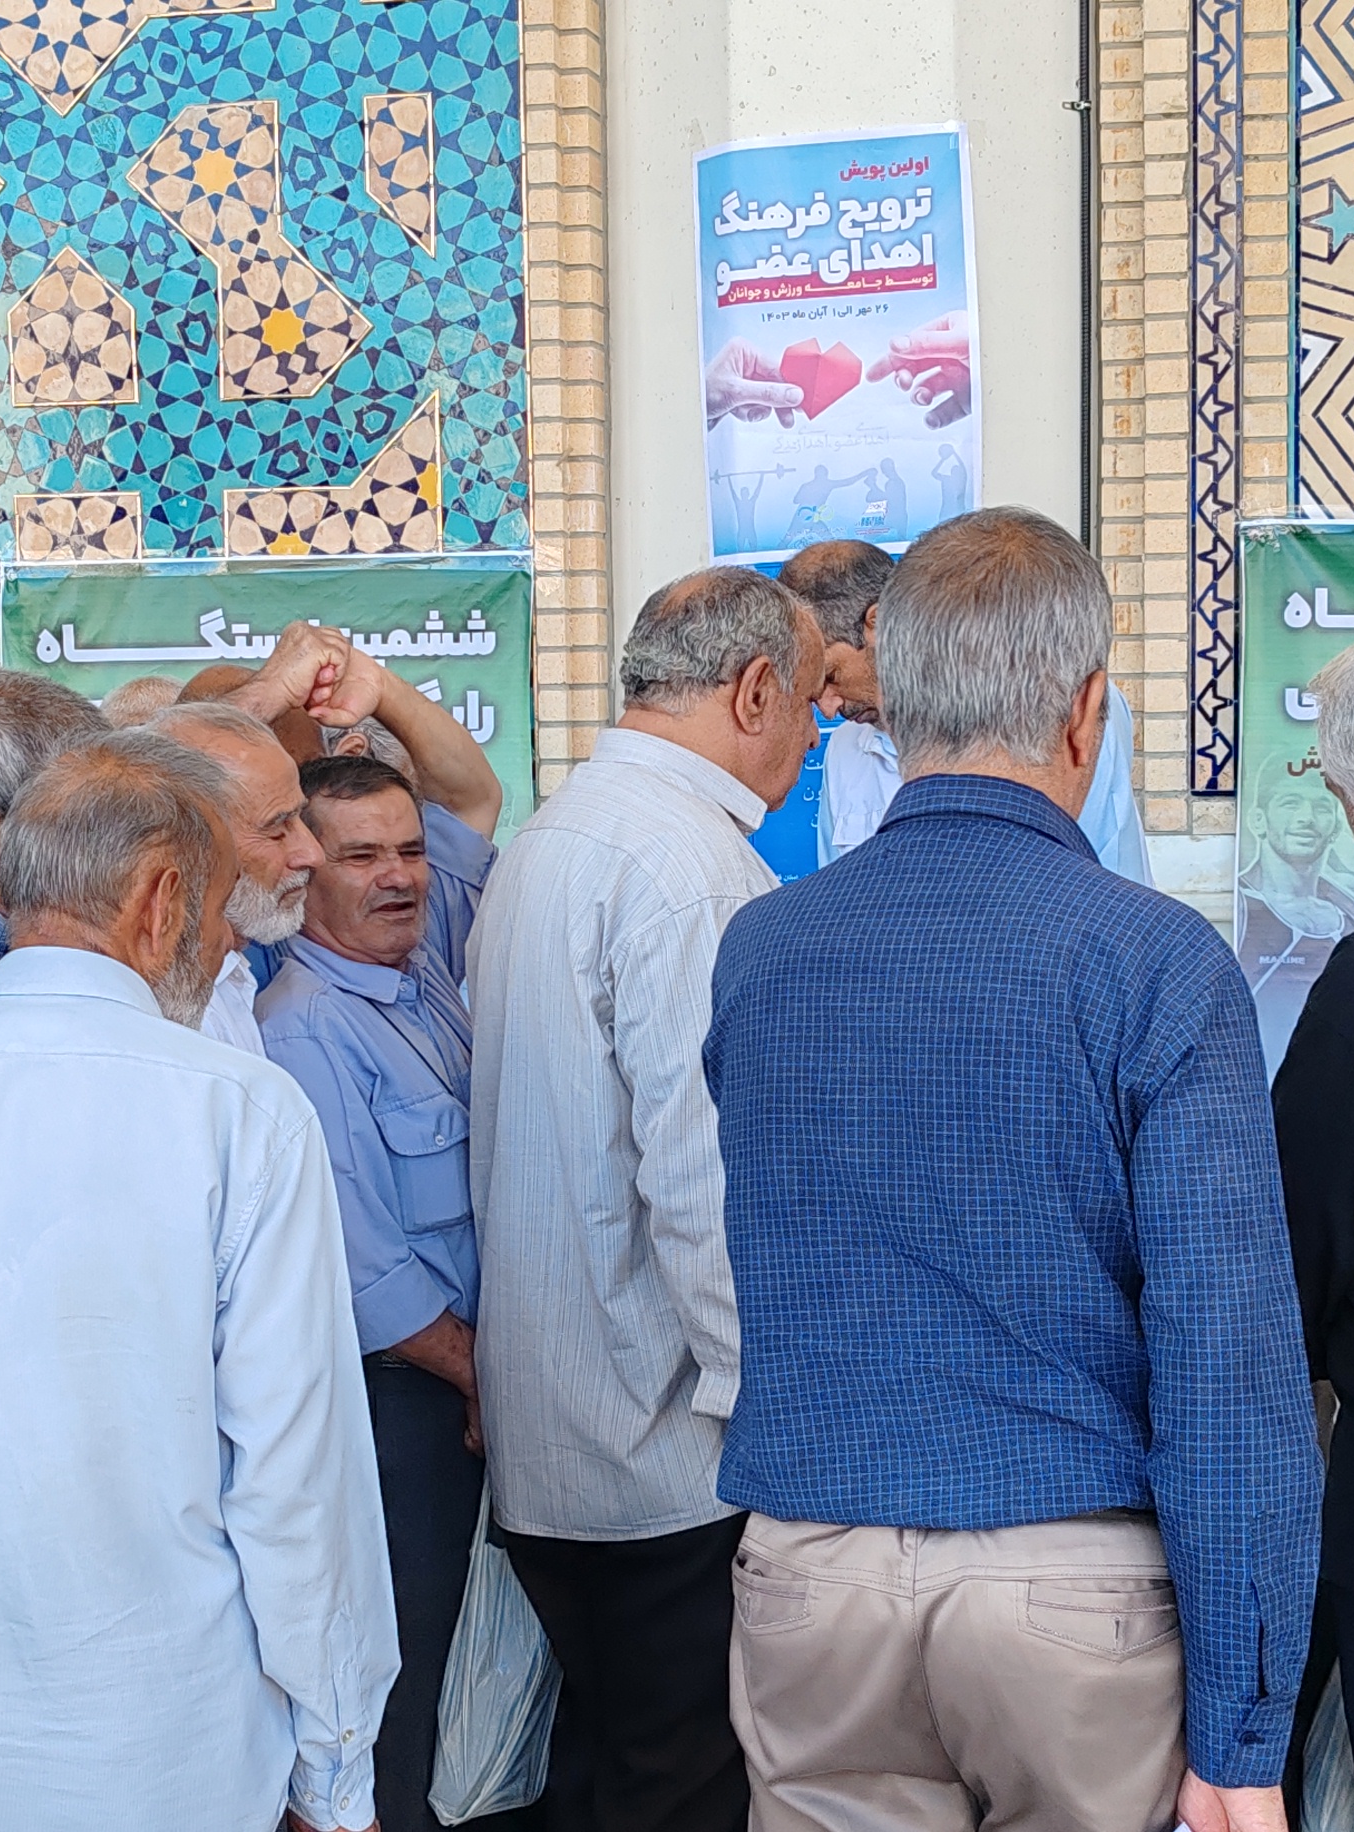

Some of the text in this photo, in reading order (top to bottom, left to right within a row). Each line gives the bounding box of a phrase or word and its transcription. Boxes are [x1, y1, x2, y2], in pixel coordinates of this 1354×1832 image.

[840, 156, 930, 182] اولین پویش
[714, 187, 932, 239] ترویج فرهنگ
[716, 233, 934, 297] اهدای عضو
[728, 286, 762, 302] جوانان
[763, 288, 770, 299] و
[772, 283, 803, 298] ورزش
[792, 309, 806, 319] ماه
[808, 305, 828, 320] آبان
